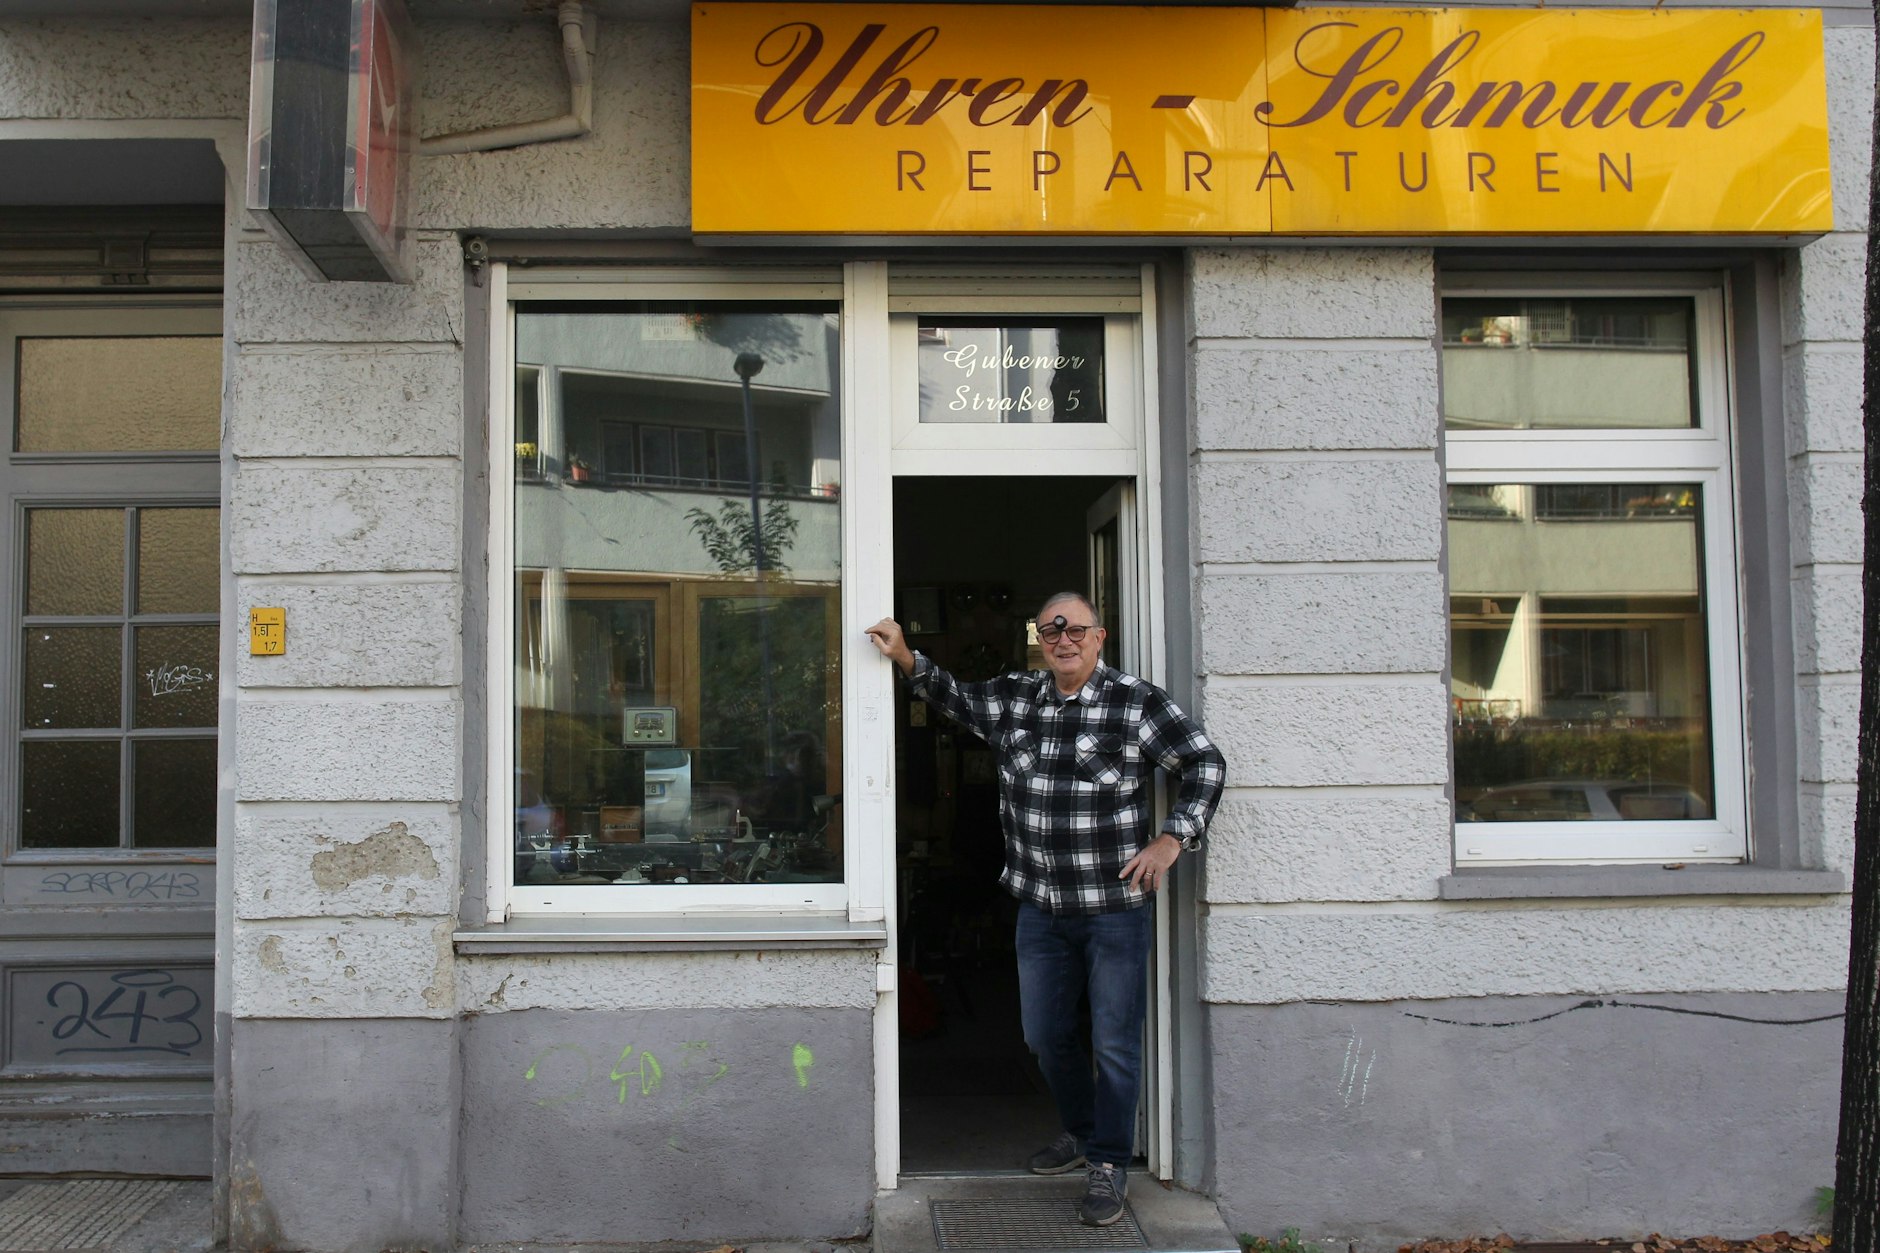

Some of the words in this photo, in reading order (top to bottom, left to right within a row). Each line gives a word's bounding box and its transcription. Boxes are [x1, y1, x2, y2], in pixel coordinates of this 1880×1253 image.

[754, 21, 1093, 128] Uhren
[1254, 21, 1766, 129] Schmuck
[897, 150, 1633, 193] REPARATUREN
[943, 344, 1085, 378] Gubener
[949, 385, 1054, 413] Straße
[1065, 389, 1081, 411] 5
[252, 613, 258, 622] H
[47, 981, 202, 1049] 243
